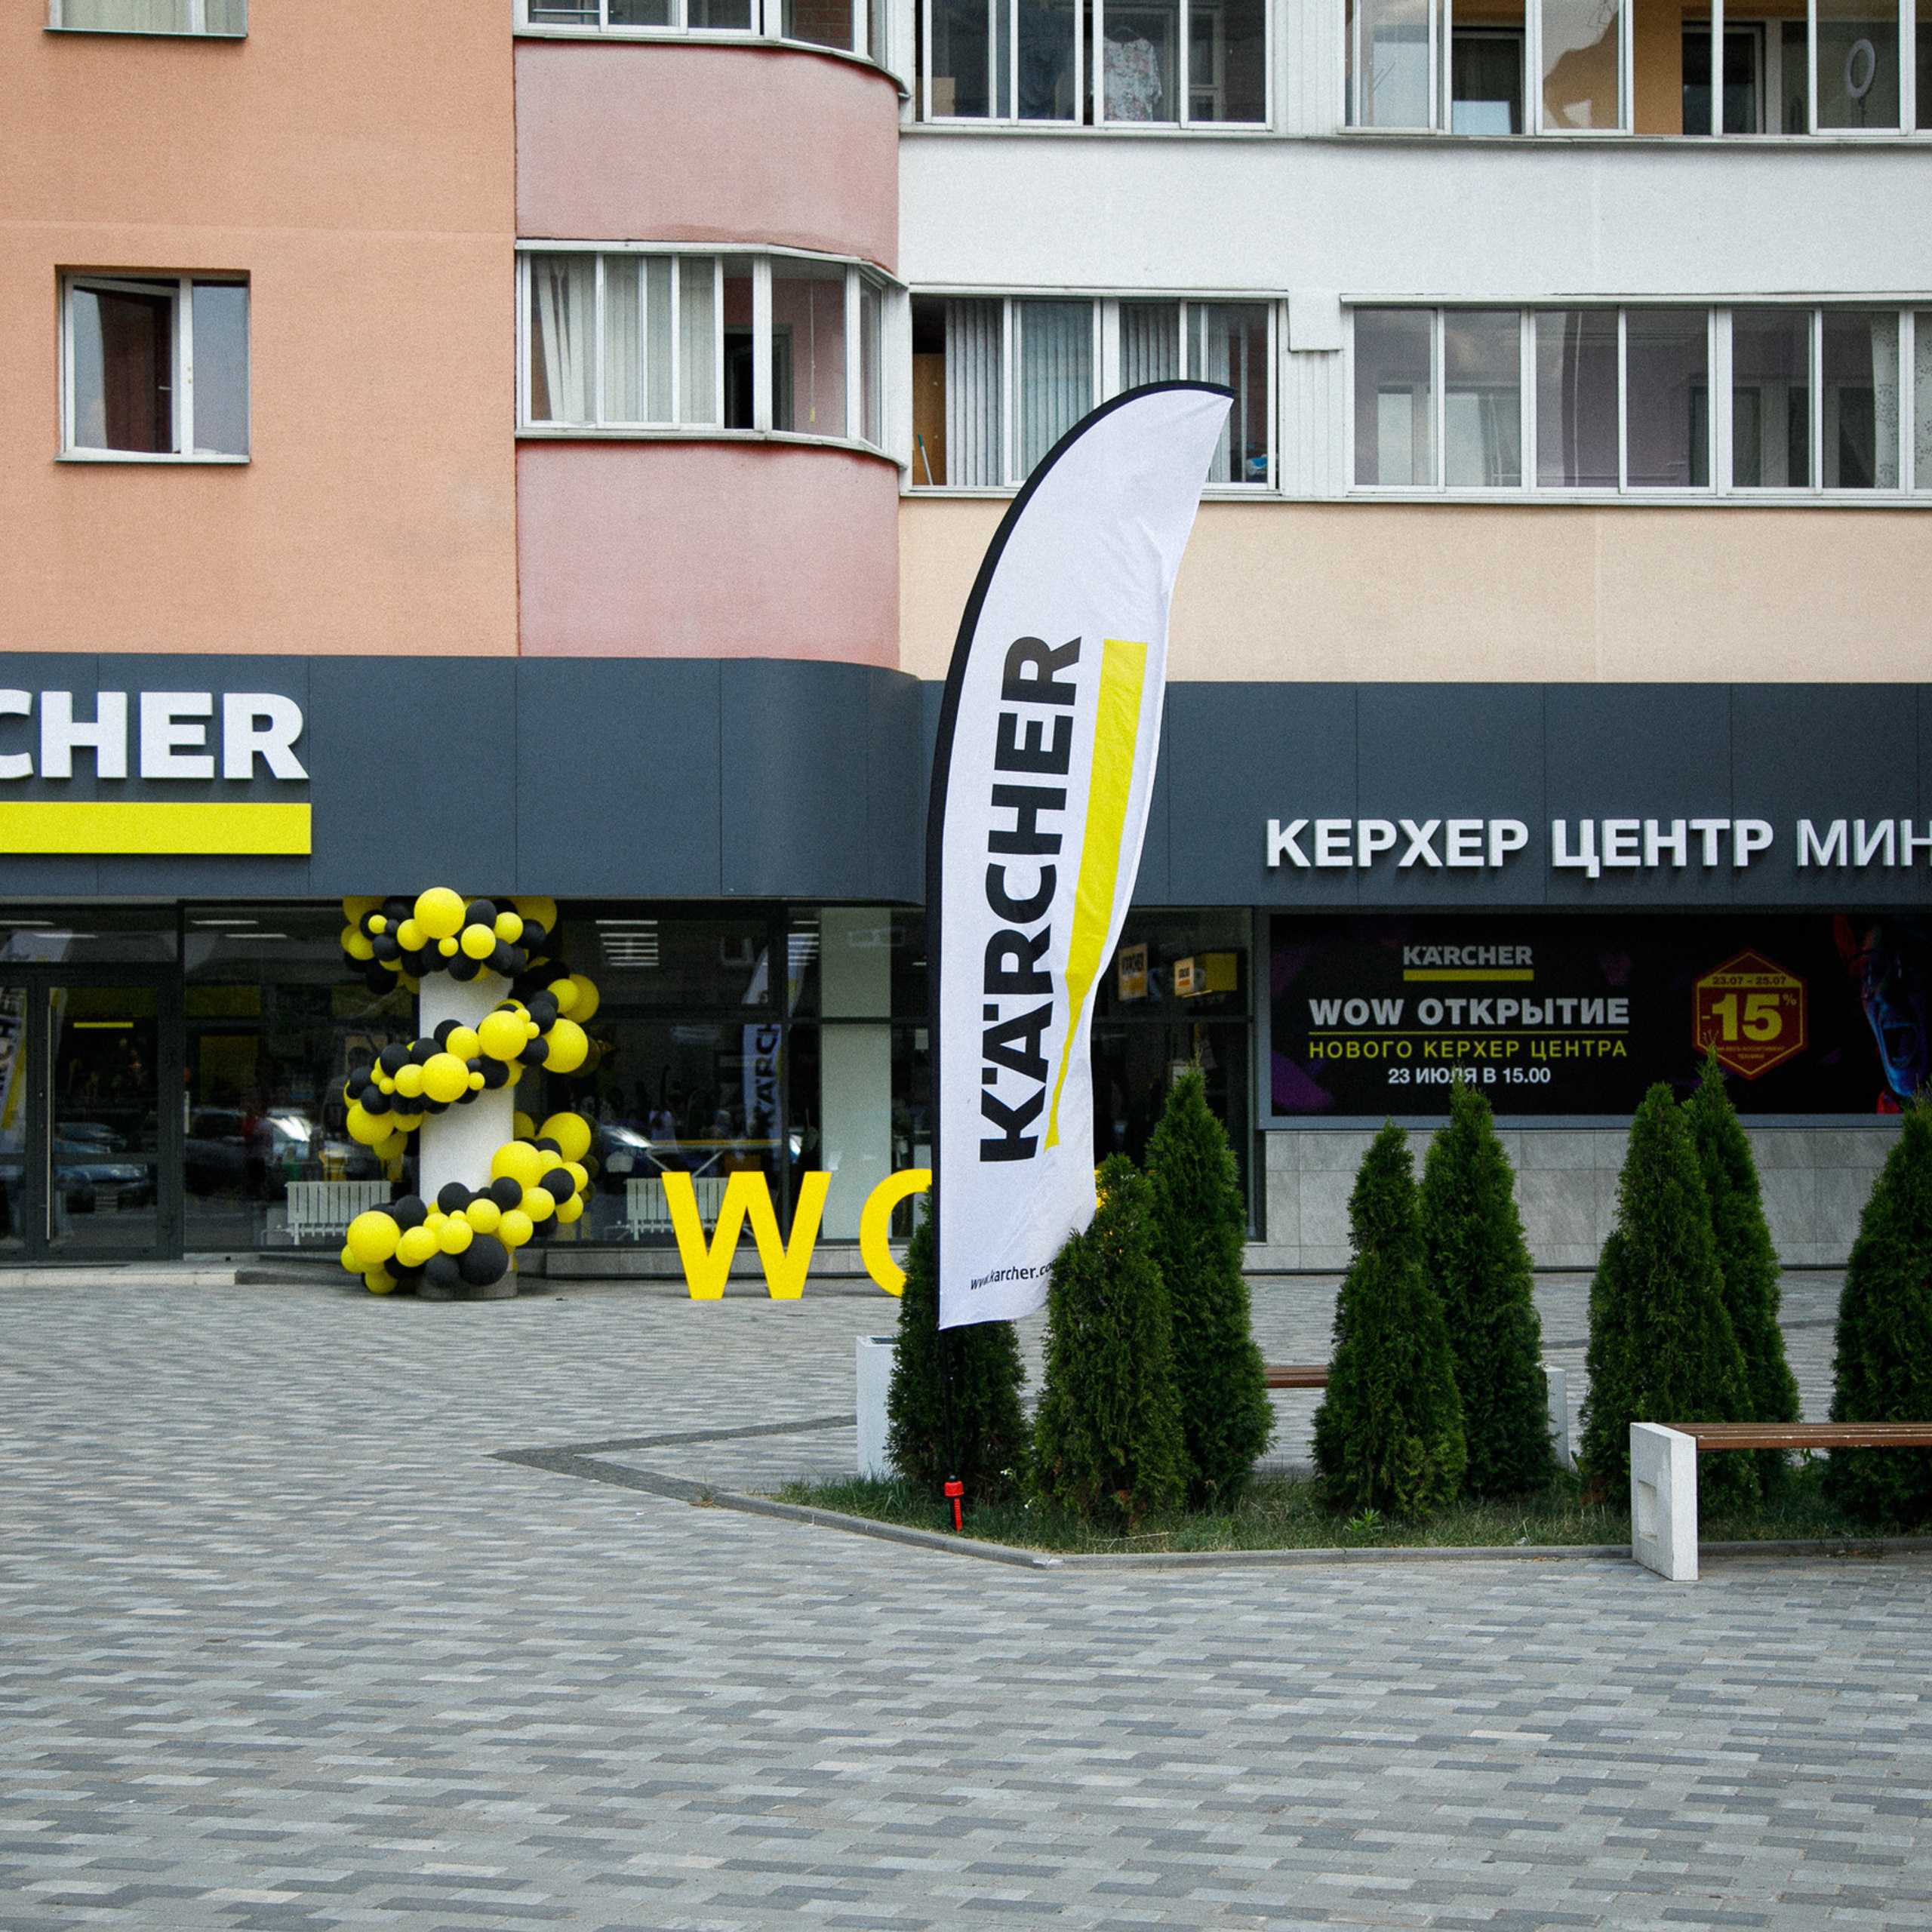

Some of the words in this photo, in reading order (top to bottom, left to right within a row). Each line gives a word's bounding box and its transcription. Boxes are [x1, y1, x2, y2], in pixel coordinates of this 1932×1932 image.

[1266, 818, 1529, 868] КЕРХЕР
[1552, 818, 1774, 878] ЦЕНТР
[1796, 818, 1932, 868] МИН
[980, 635, 1082, 1163] KÄRCHER
[1403, 945, 1533, 966] KÄRCHER
[1712, 976, 1744, 985] 23.07
[1755, 976, 1786, 985] 25.07
[1309, 998, 1404, 1026] WOW
[1417, 997, 1630, 1026] ОТКРЫТИЕ
[1309, 1041, 1413, 1059] НОВОГО
[1424, 1040, 1520, 1058] КЕРХЕР
[1531, 1040, 1628, 1061] ЦЕНТРА
[1388, 1068, 1411, 1084] 23
[1483, 1067, 1497, 1084] В
[1503, 1066, 1552, 1084] 15.00
